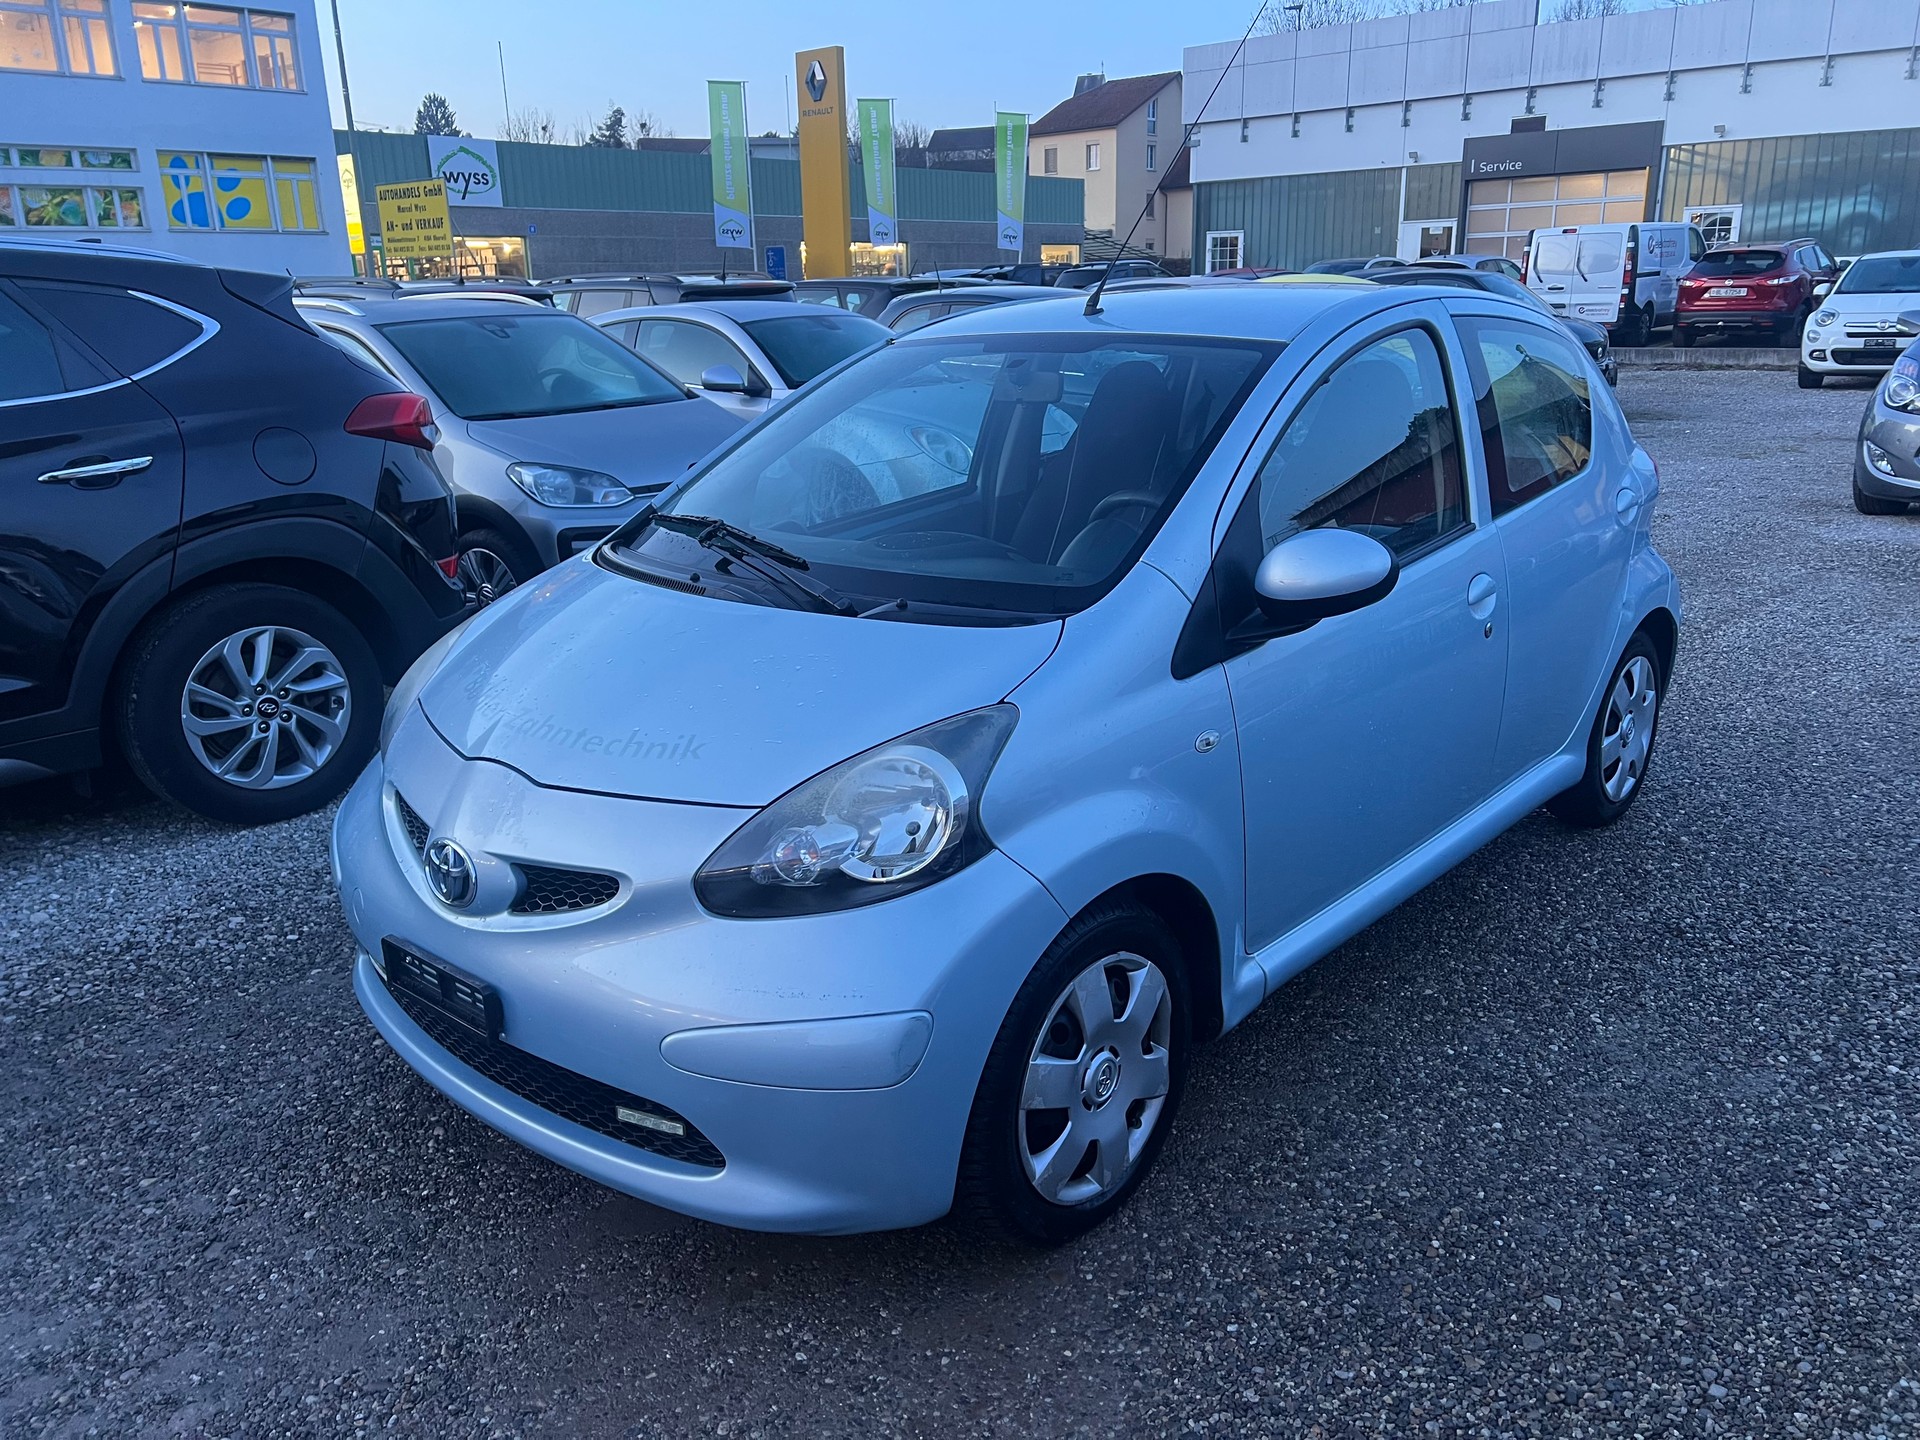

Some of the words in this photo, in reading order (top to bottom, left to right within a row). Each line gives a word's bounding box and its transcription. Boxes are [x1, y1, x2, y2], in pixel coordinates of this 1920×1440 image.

[802, 106, 834, 117] RENAULT
[1480, 160, 1522, 173] Service
[442, 170, 490, 200] wyss
[379, 186, 421, 201] AUTOHANDELS
[423, 184, 443, 198] GmbH
[397, 204, 413, 213] Marcel
[414, 203, 427, 213] Wyss
[401, 221, 413, 231] und
[415, 217, 444, 230] VERKAUF
[502, 707, 705, 760] Zahntechnik
